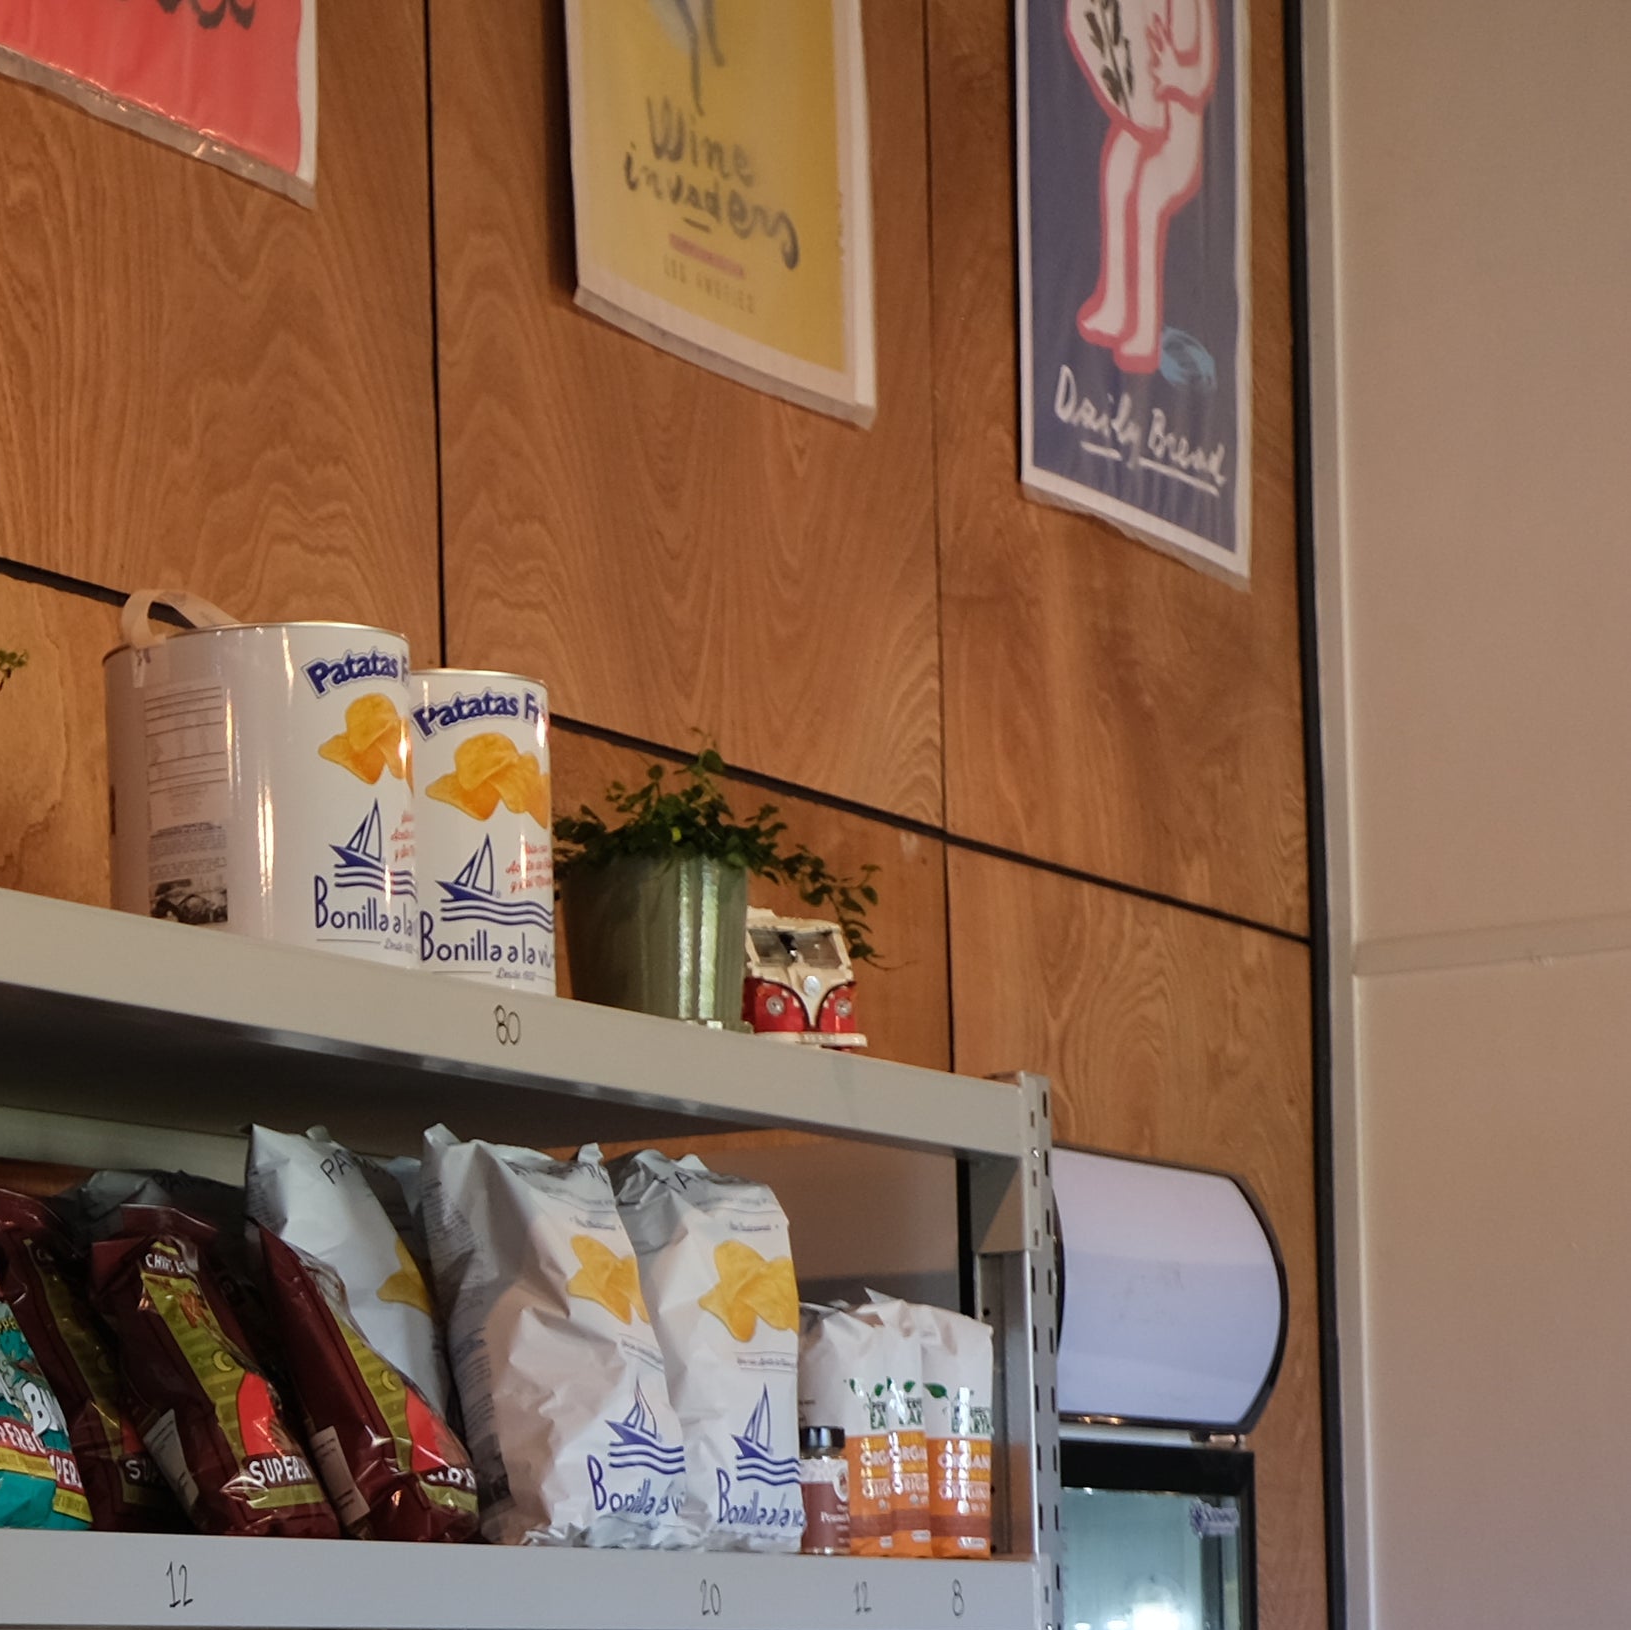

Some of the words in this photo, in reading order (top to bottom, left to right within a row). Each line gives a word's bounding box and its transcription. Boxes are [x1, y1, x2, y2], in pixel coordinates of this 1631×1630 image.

[646, 96, 755, 188] Wine
[1055, 364, 1140, 471] Daily
[1148, 408, 1226, 486] Bread
[303, 646, 401, 698] Patatas
[411, 690, 520, 740] Patatas
[314, 875, 390, 932] Bonilla
[420, 911, 503, 964] Bonilla
[493, 1005, 521, 1045] 80
[165, 1561, 194, 1608] 12
[699, 1579, 722, 1618] 20
[852, 1581, 873, 1614] 12
[952, 1580, 965, 1617] 8
